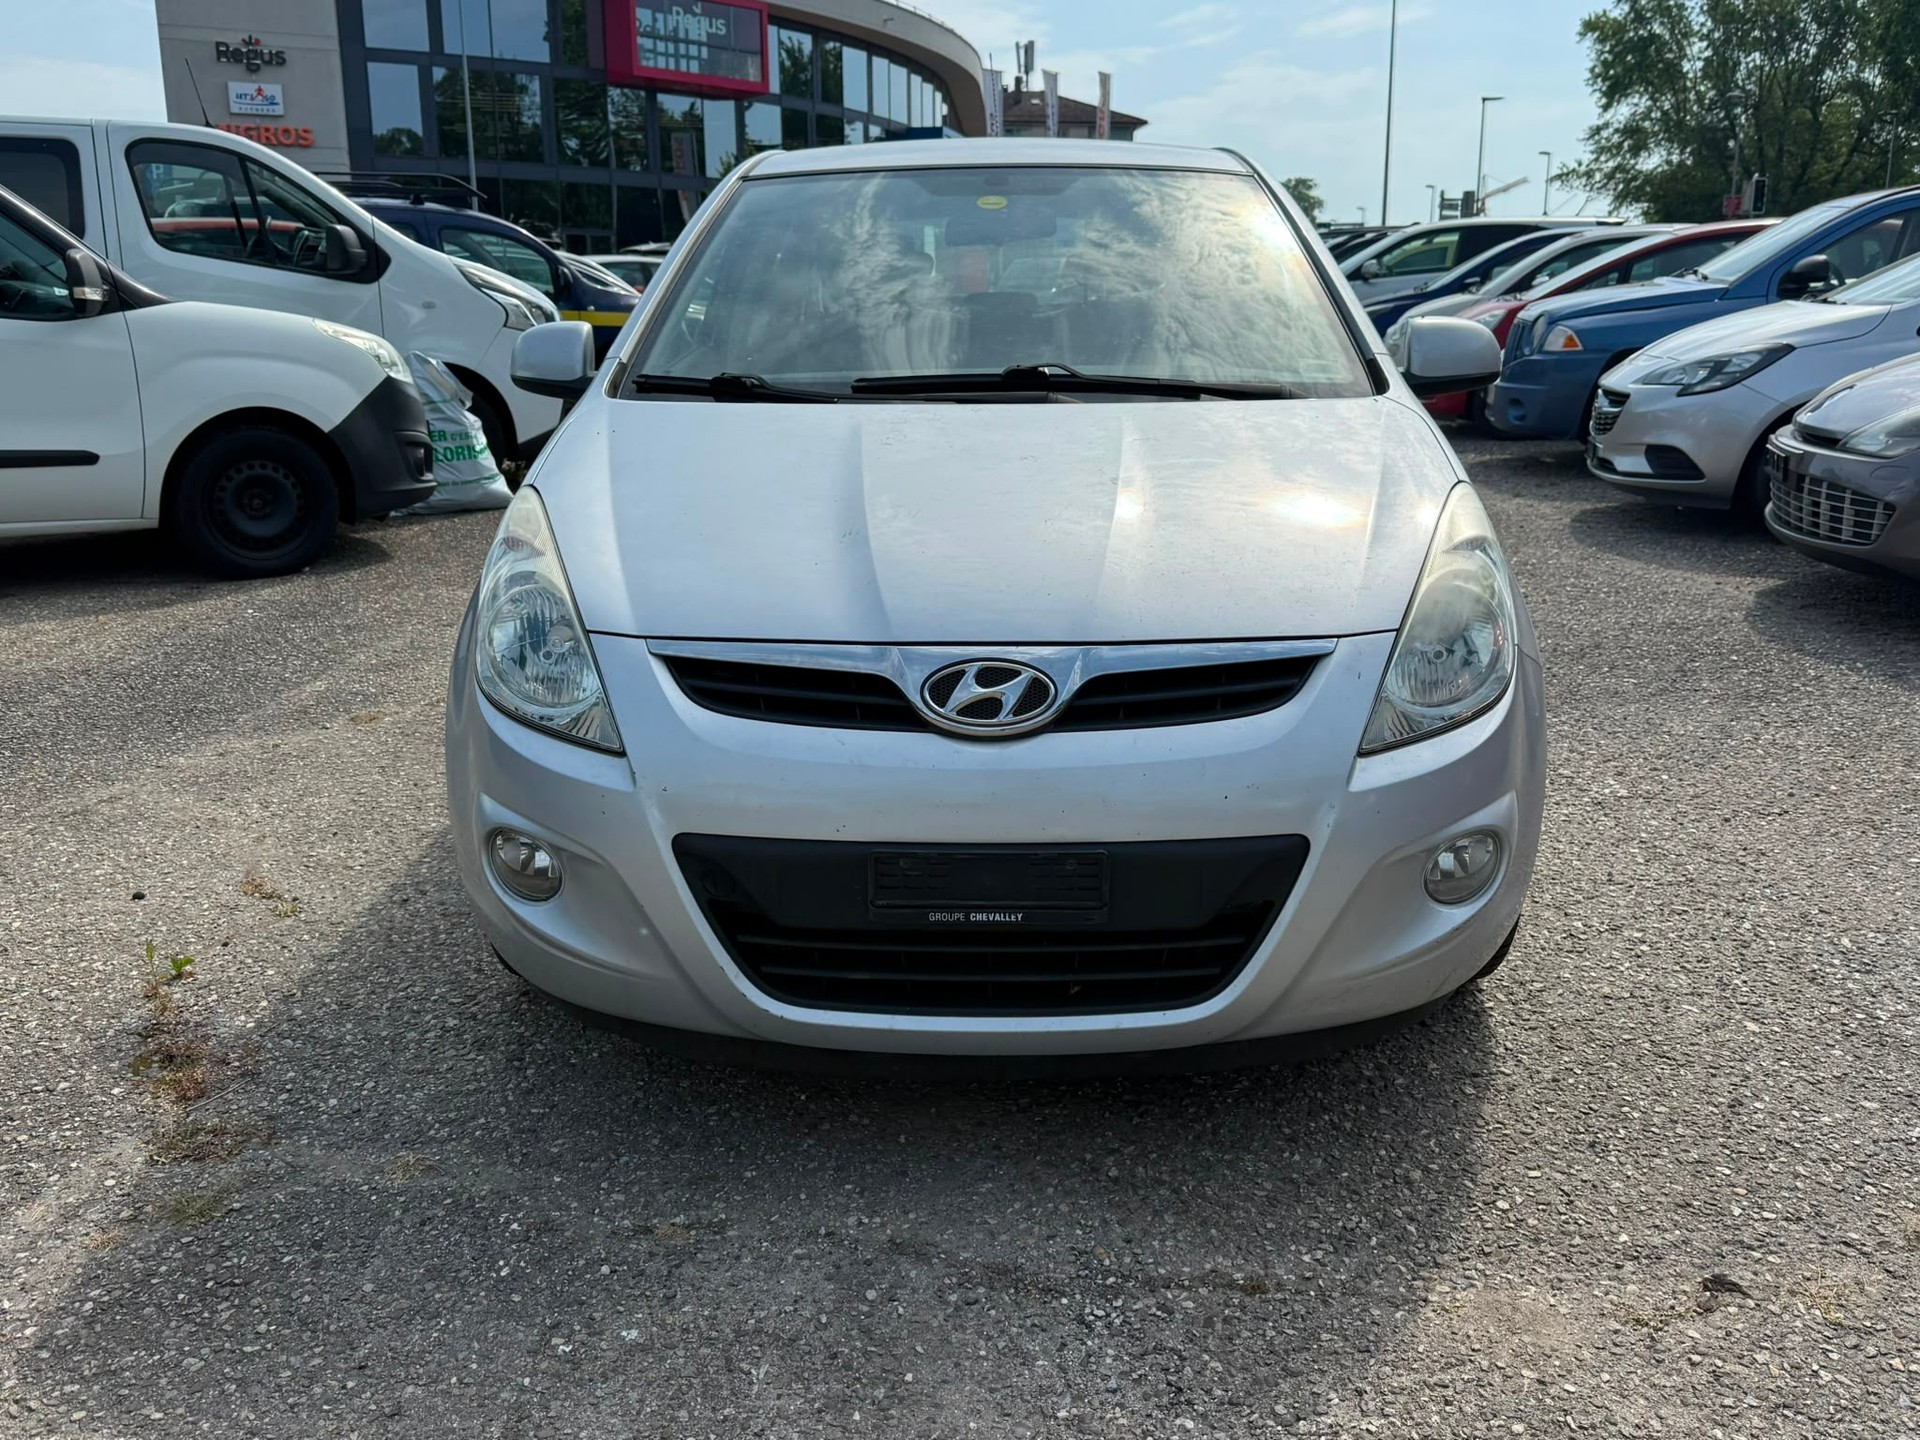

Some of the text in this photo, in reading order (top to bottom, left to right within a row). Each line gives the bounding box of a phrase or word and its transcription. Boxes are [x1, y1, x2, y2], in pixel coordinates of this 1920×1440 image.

[672, 4, 727, 38] Regus
[215, 38, 287, 72] Regus
[928, 912, 1023, 921] GROUPE CHEVALLEY
